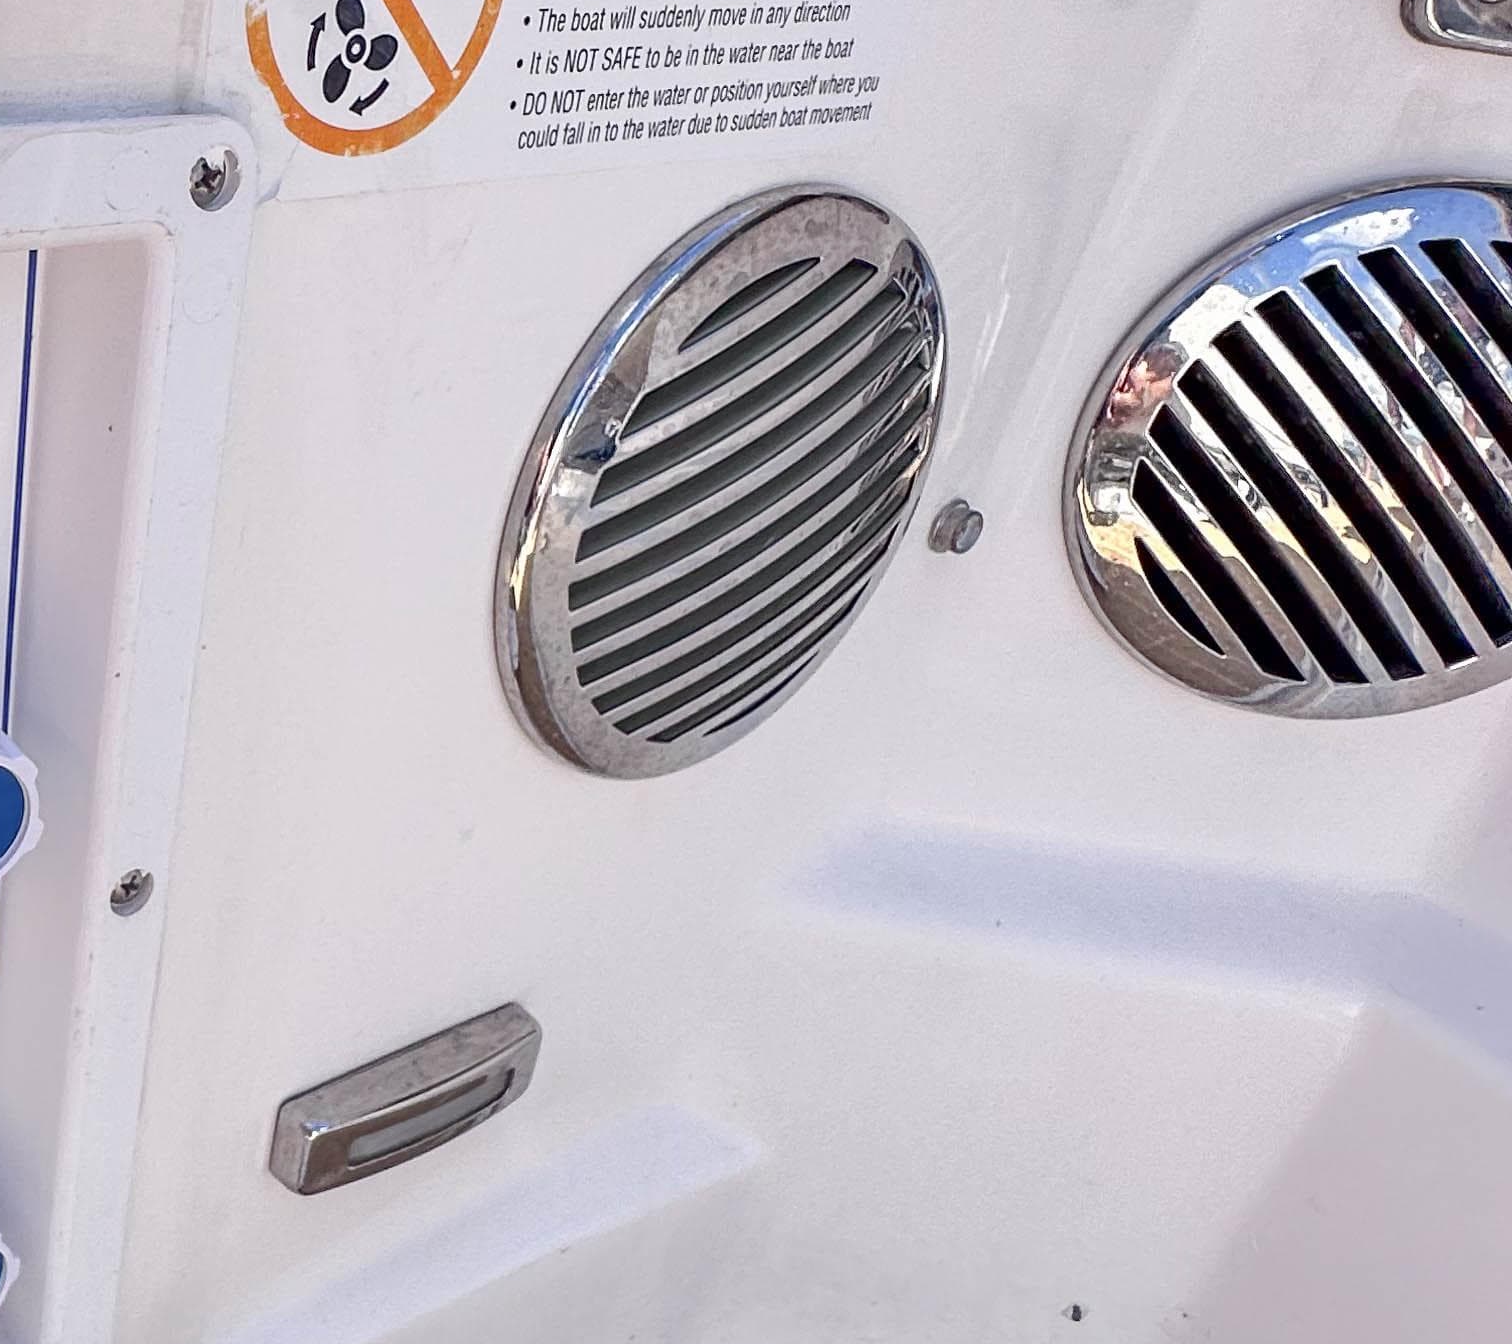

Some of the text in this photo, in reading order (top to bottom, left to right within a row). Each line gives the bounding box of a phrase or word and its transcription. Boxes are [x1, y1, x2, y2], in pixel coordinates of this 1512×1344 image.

[538, 0, 851, 32] The boat will suddenly move in any direction
[529, 37, 854, 74] It is NOT SAFE to be in the water near the boat
[522, 73, 880, 116] DO NOT enter the water or position yourself where you
[517, 101, 872, 149] could fall in to the water due to sudden boat movement
